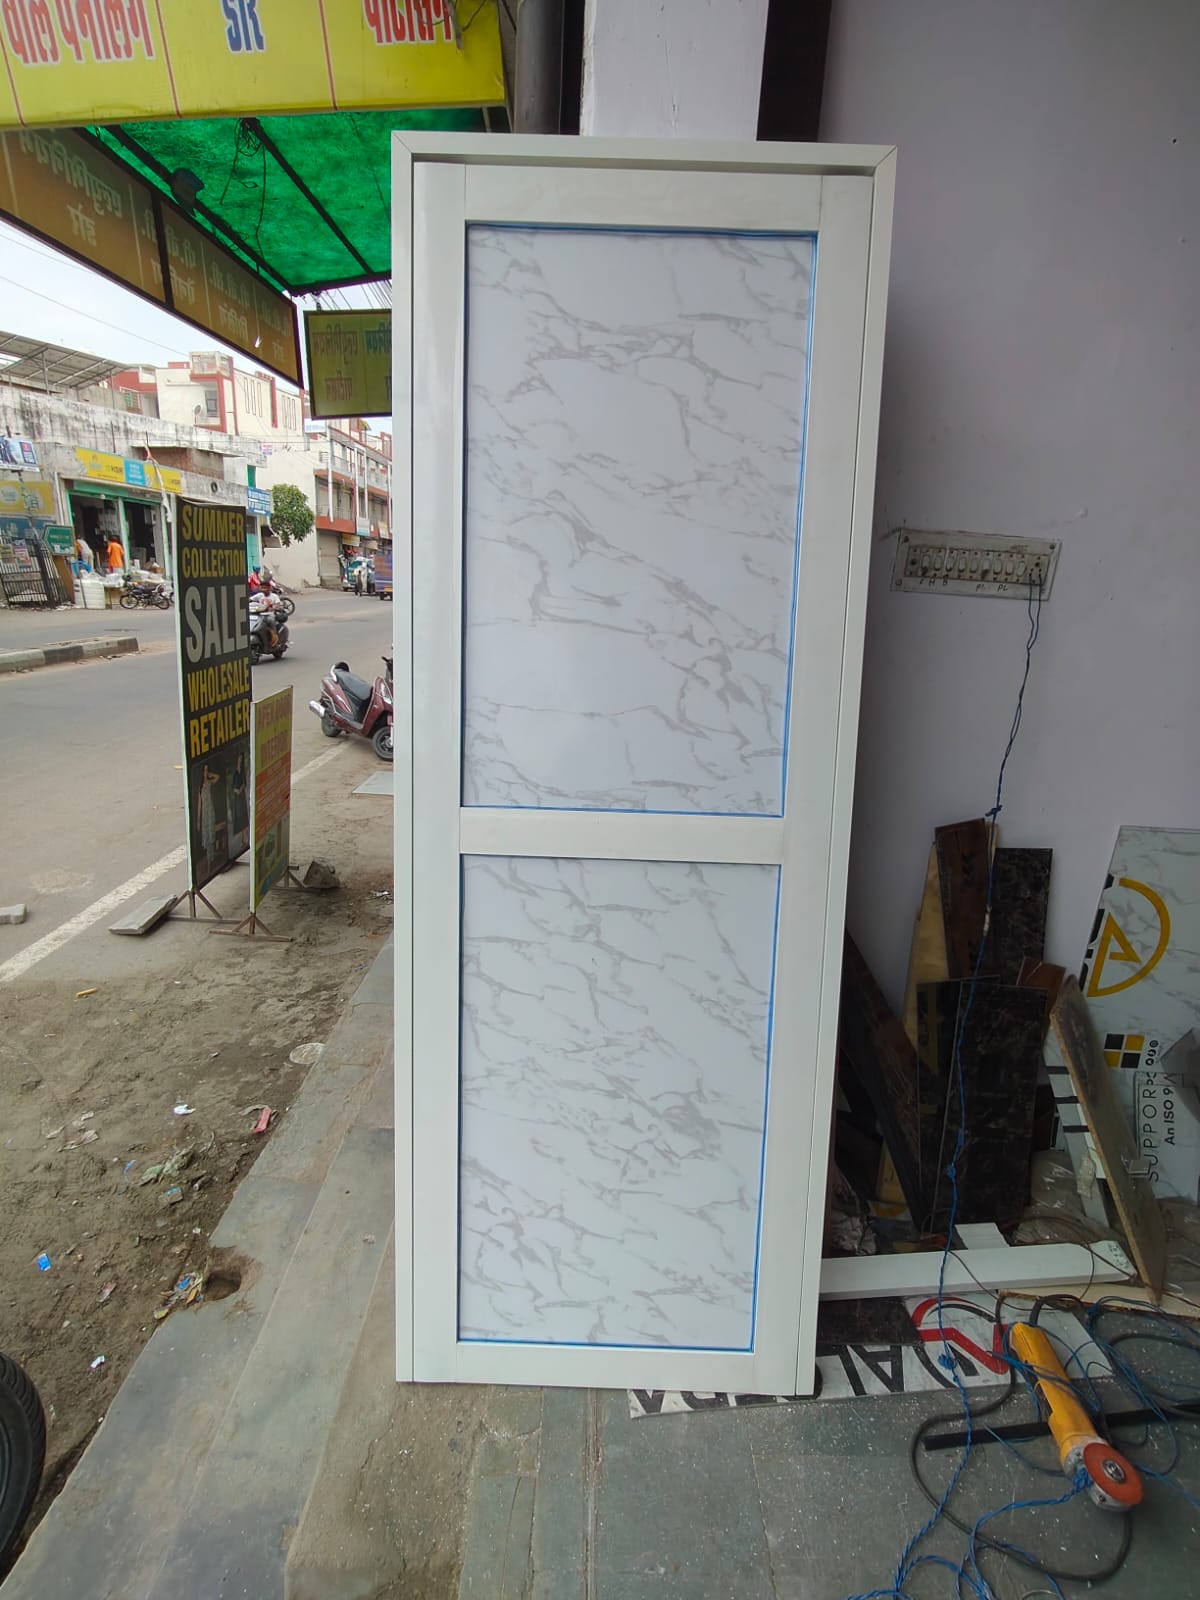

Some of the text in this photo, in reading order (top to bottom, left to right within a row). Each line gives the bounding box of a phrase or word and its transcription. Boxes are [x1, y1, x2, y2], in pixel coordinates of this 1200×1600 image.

[182, 504, 244, 542] SUMMER
[182, 546, 246, 578] COLLECTION
[184, 584, 249, 663] SALE
[187, 656, 250, 713] WHOLESALE
[189, 698, 250, 758] RETAILER
[1163, 1100, 1175, 1123] ISO
